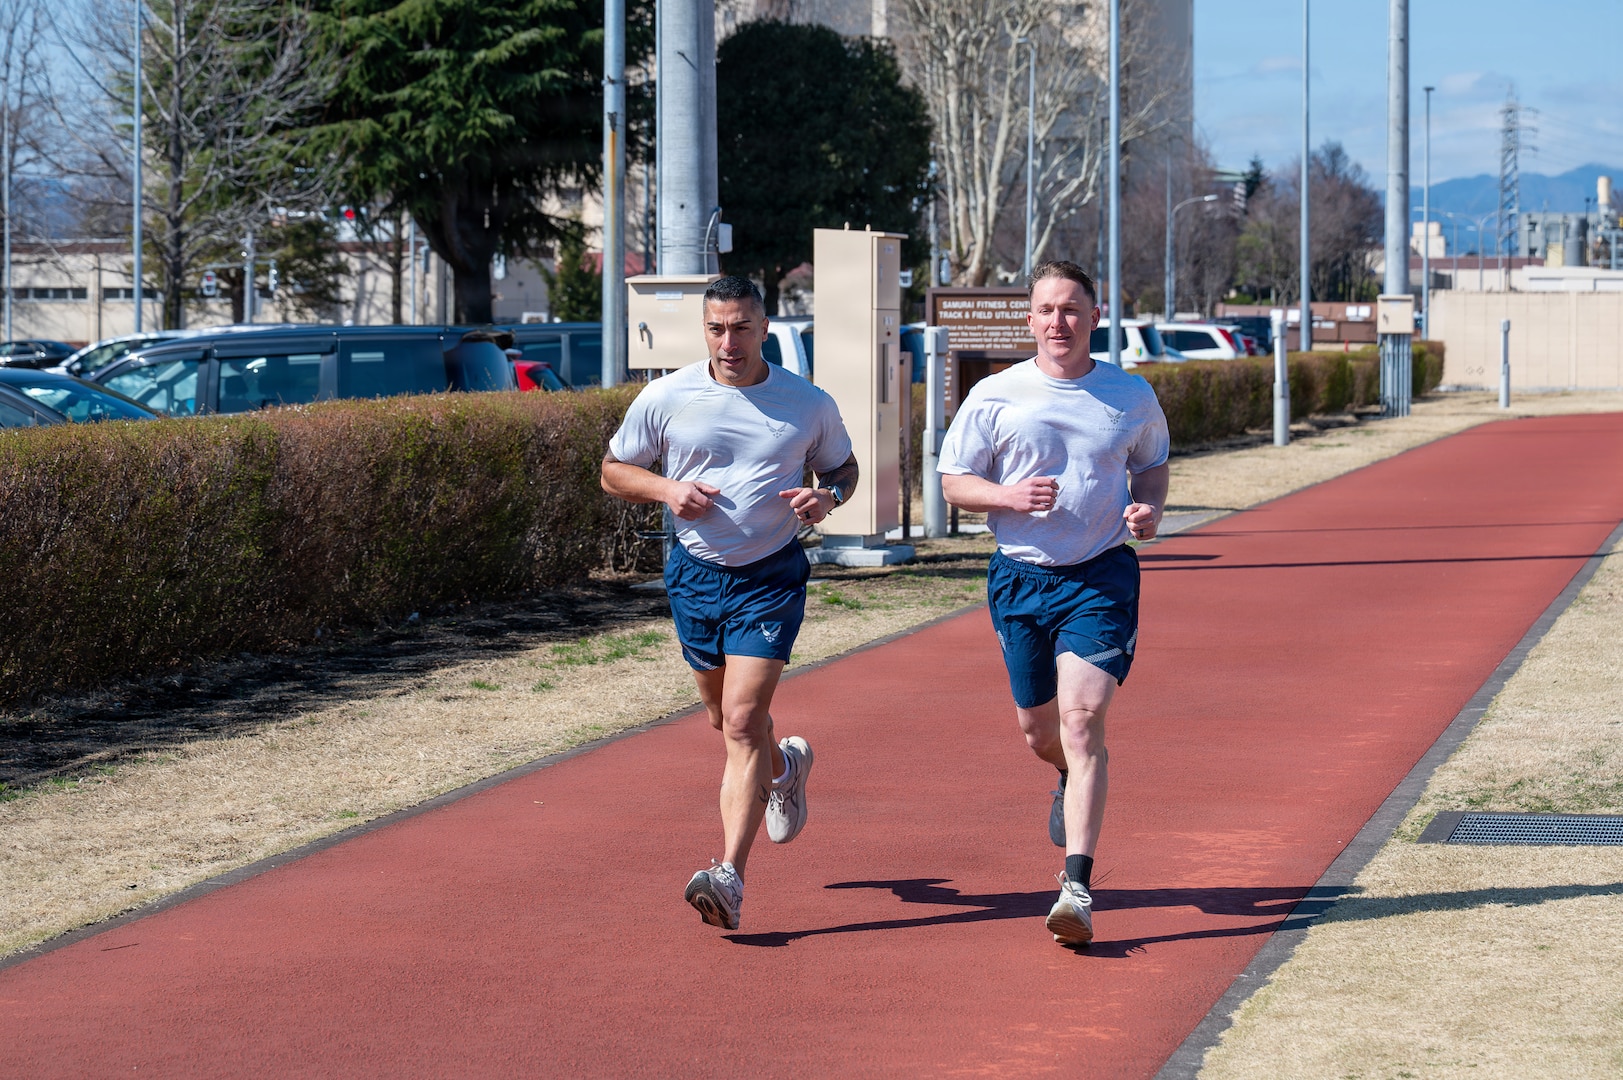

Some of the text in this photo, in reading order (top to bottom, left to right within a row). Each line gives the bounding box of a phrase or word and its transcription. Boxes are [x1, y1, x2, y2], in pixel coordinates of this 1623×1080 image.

[942, 301, 974, 309] SAMURAI
[976, 300, 1007, 309] FITNESS
[939, 311, 963, 319] TRACK
[964, 311, 970, 319] &
[972, 311, 993, 319] FIELD
